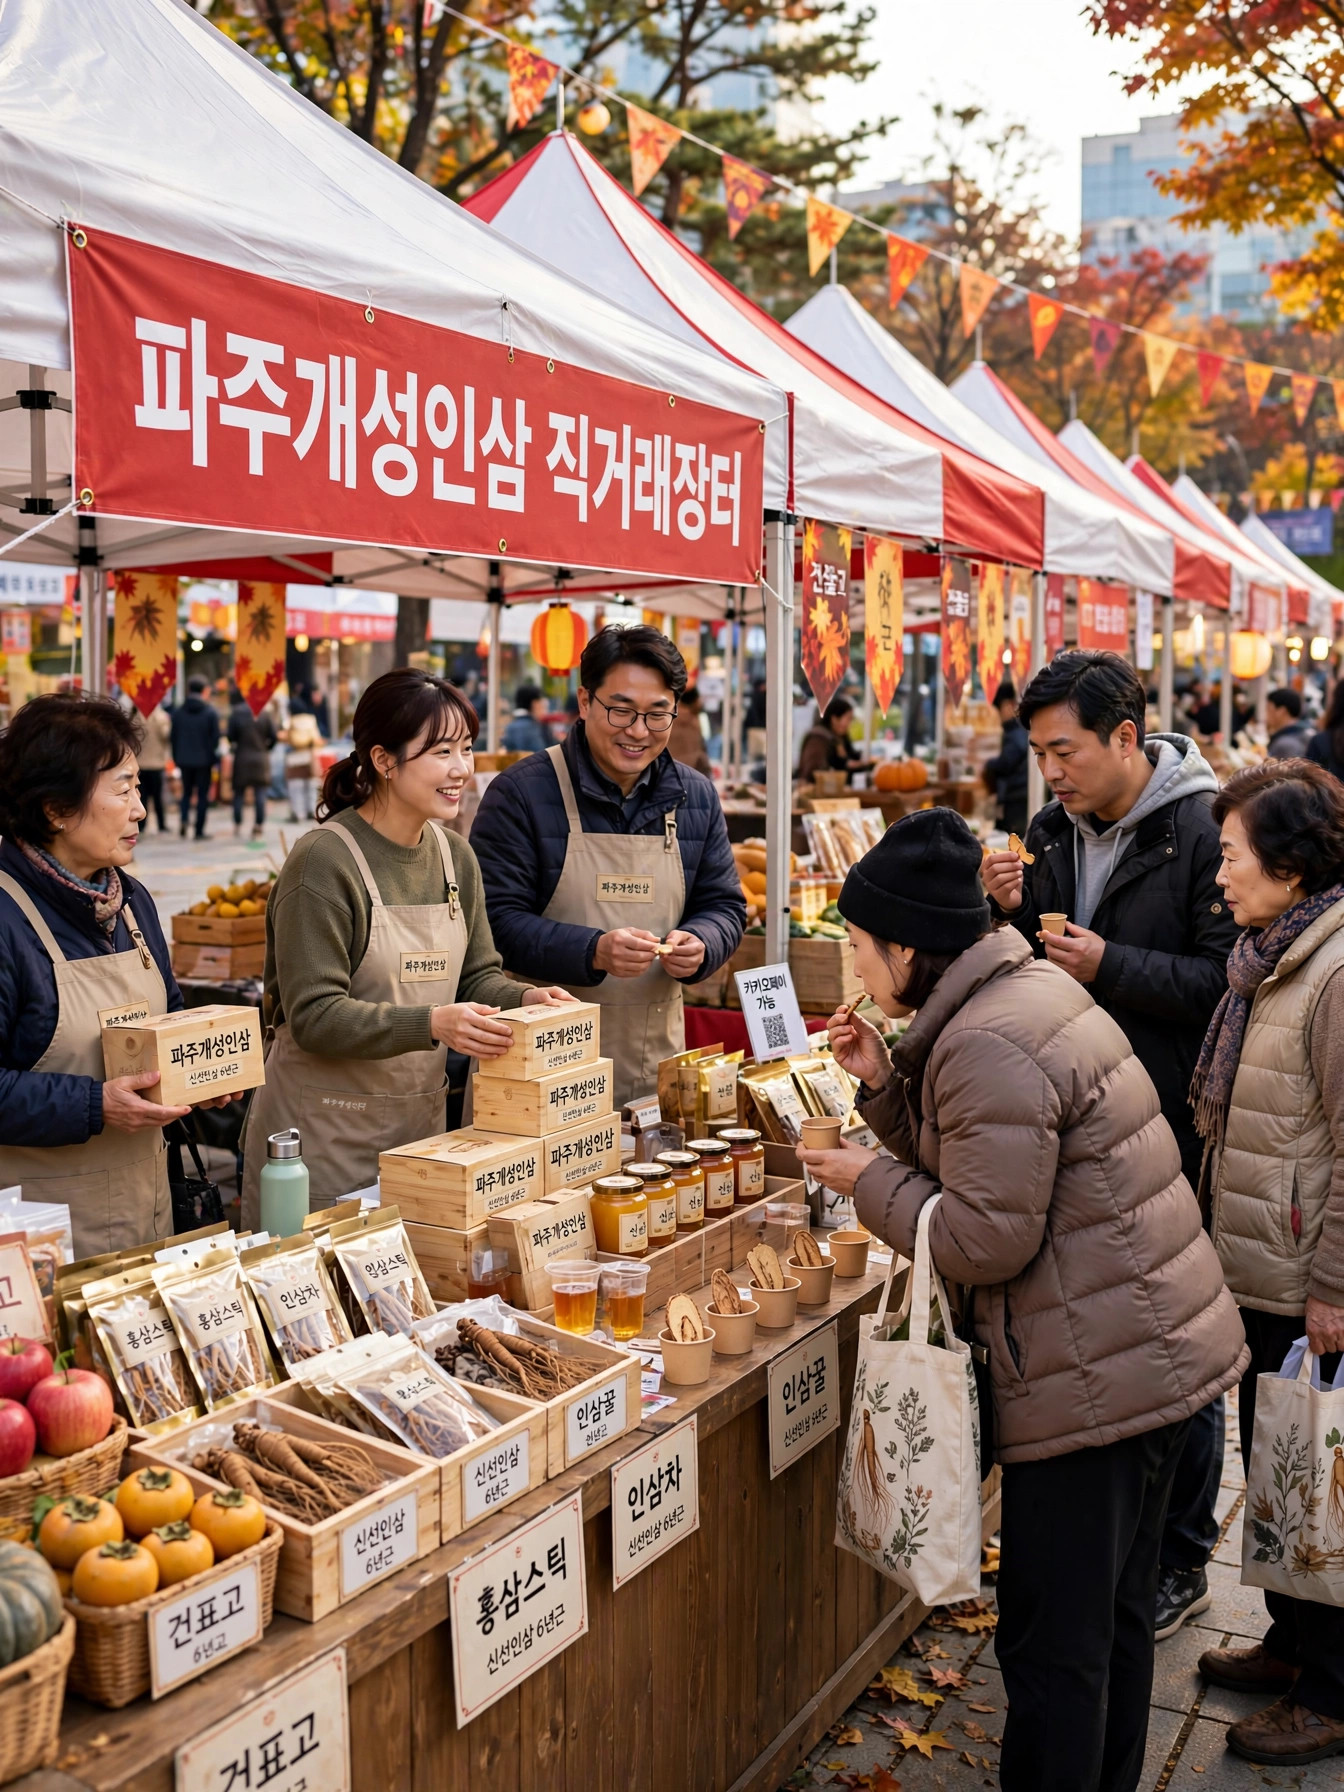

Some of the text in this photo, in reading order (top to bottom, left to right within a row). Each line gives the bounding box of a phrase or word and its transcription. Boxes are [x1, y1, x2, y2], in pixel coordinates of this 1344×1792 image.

[134, 316, 742, 547] 파주개성인삼 직거래장터
[756, 995, 776, 1011] 가능
[171, 1029, 252, 1068] 파주개성인삼
[551, 1128, 615, 1167] 파주개성인삼
[475, 1157, 536, 1194] 파주개성인삼
[532, 1212, 587, 1247] 파주개성인삼
[198, 1299, 245, 1331] 홍삼스틱
[280, 1283, 321, 1310] 인삼차
[782, 1356, 827, 1415] 인삼꿀
[577, 1389, 616, 1431] 인삼꿀
[474, 1444, 520, 1488] 신선인삼
[485, 1479, 511, 1504] 6년근
[627, 1454, 683, 1522] 인삼차
[354, 1509, 406, 1555] 신선인삼
[628, 1504, 685, 1557] 신선인삼 6년근
[366, 1547, 395, 1575] 6년근
[476, 1536, 567, 1636] 홍삼스틱
[168, 1585, 245, 1649] 건표고
[487, 1603, 566, 1675] 신선인삼 6년근
